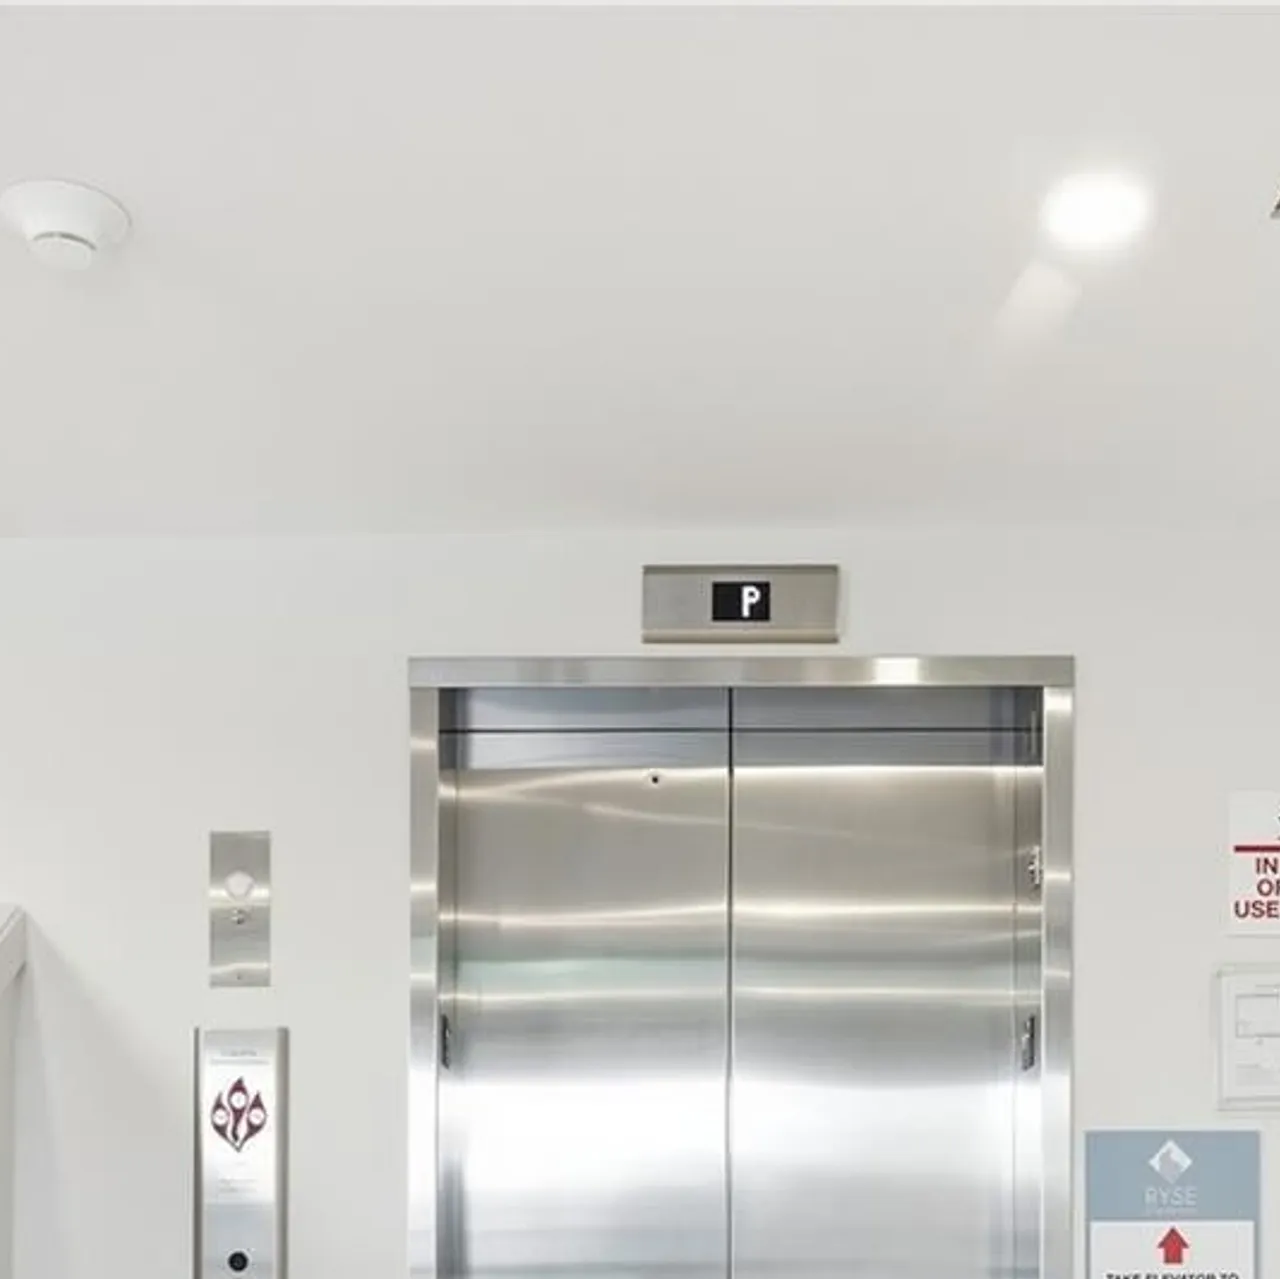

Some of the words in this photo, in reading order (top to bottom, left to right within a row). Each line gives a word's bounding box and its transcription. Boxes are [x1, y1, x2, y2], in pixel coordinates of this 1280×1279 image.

[741, 585, 761, 618] P
[1255, 857, 1278, 875] IN
[1234, 900, 1280, 918] USE
[1144, 1187, 1197, 1206] RYSE
